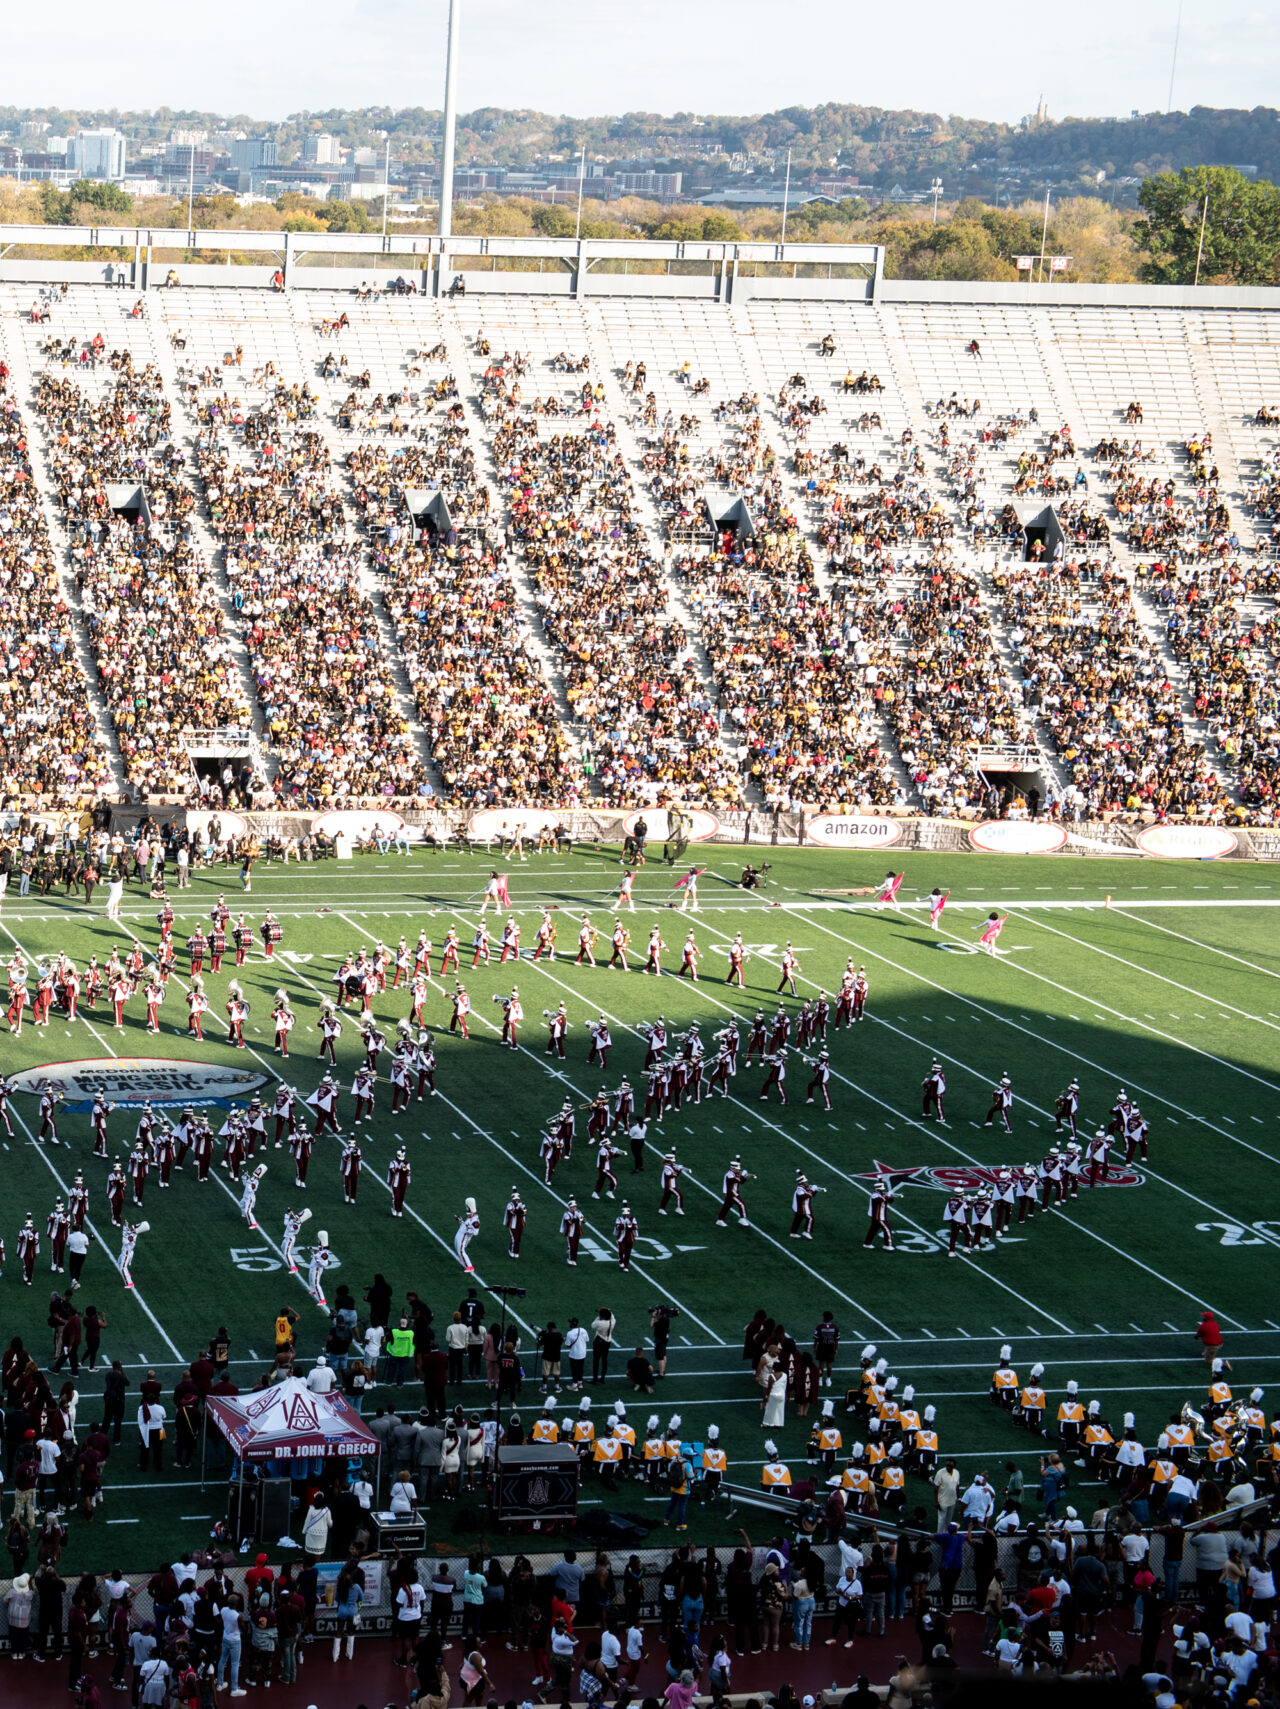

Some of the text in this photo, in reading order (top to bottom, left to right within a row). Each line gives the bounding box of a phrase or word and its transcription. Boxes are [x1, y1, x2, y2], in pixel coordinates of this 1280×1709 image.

[825, 822, 888, 836] amazon
[72, 1073, 194, 1083] MAGIC CITY
[78, 1080, 205, 1093] CLASSIC
[114, 1100, 217, 1109] RMNGHAM
[924, 1162, 1147, 1191] SWC
[215, 1348, 228, 1362] 12
[275, 1442, 376, 1458] DR. JOHN J. GRECO
[316, 1619, 373, 1632] CAAL
